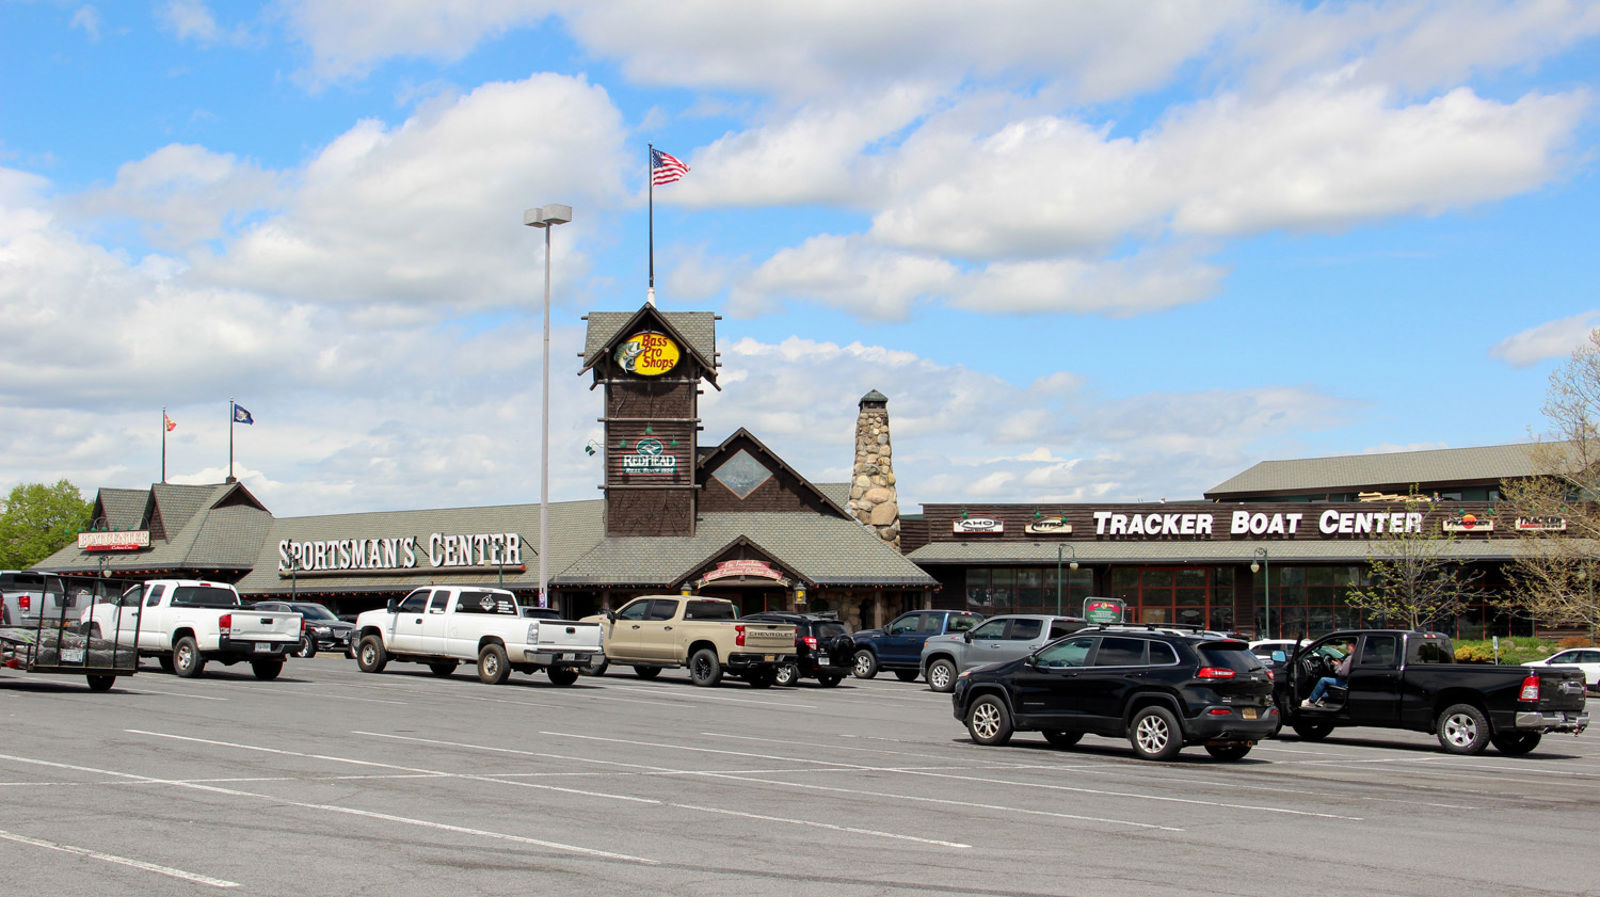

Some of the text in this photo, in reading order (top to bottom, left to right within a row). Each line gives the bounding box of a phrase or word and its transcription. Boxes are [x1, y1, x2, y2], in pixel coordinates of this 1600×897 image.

[641, 334, 668, 347] Bass
[643, 346, 662, 357] Pro
[641, 356, 674, 370] Shops
[1093, 509, 1423, 535] TRACKER BOAT CENTER
[105, 531, 148, 546] CENTER
[278, 531, 522, 571] SPORTSMAN'S CENTER
